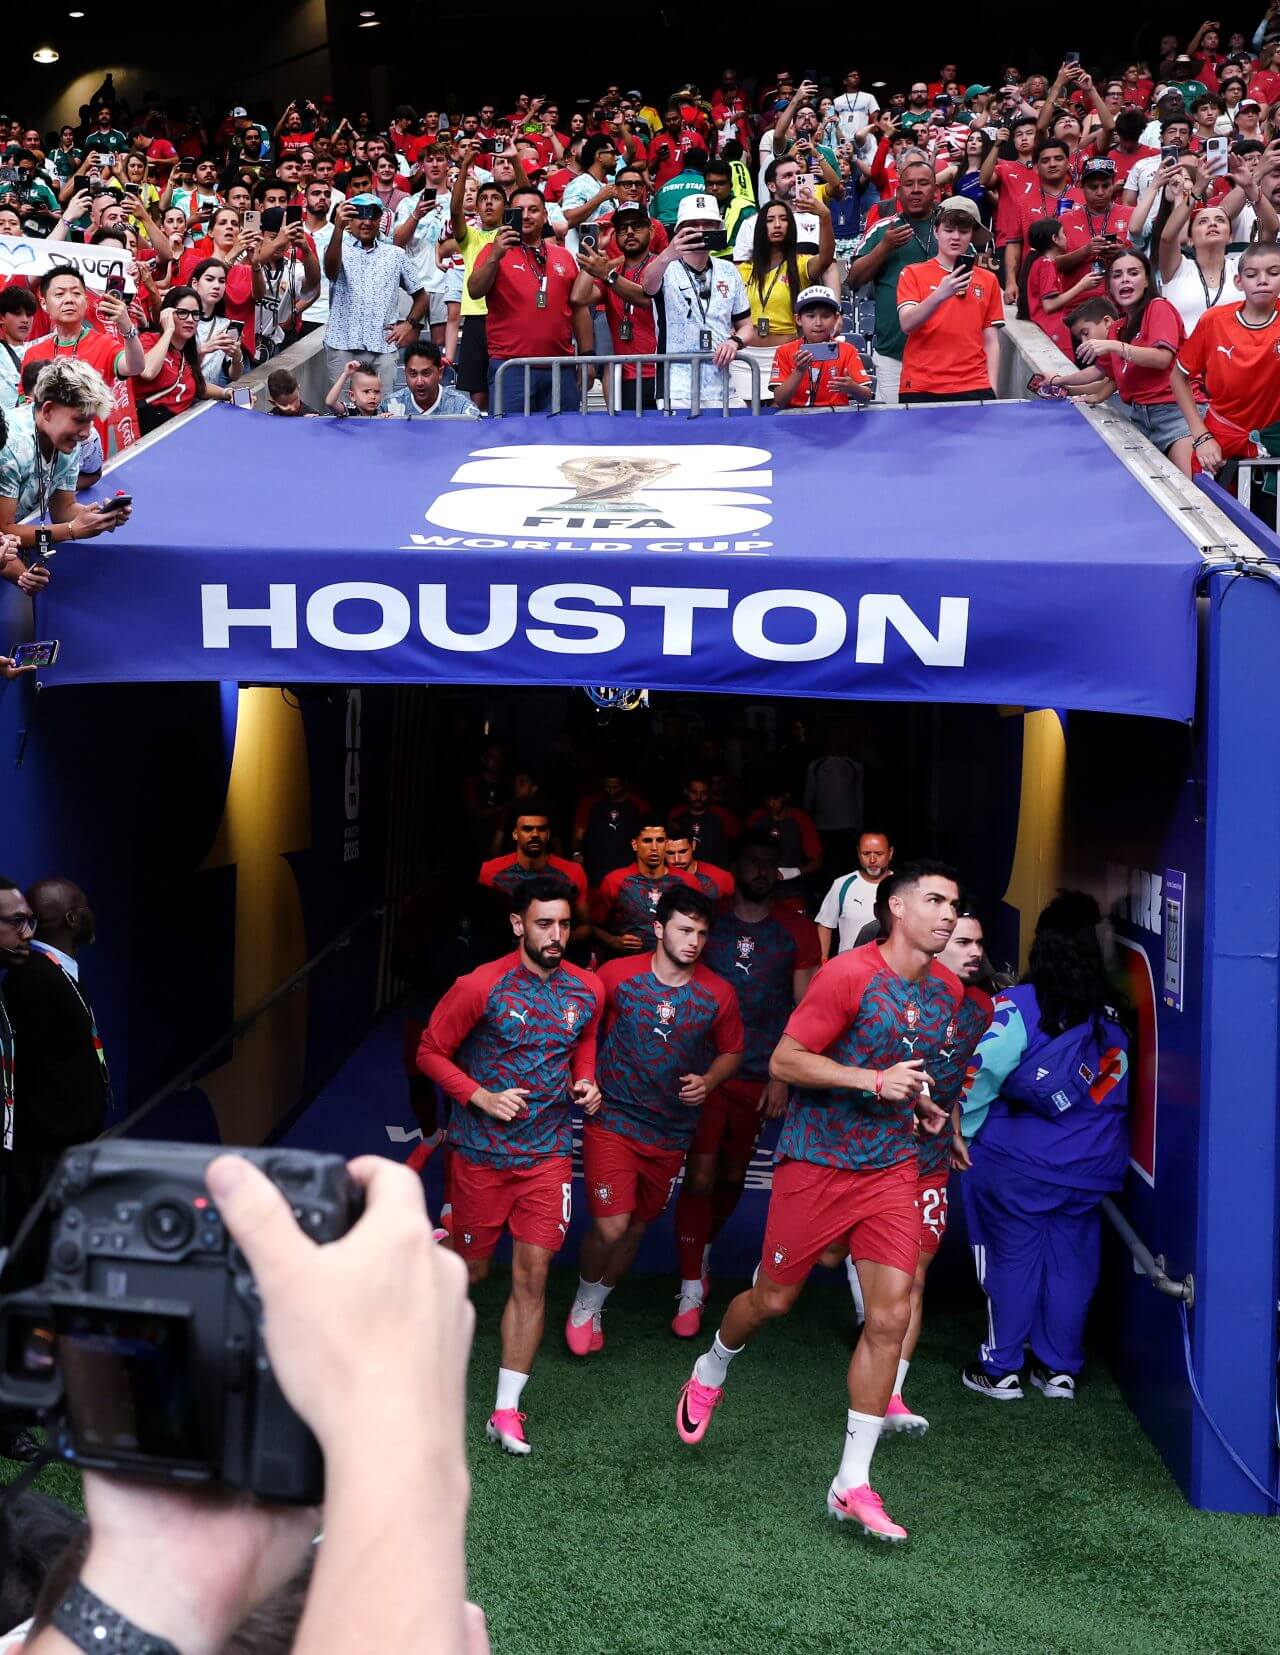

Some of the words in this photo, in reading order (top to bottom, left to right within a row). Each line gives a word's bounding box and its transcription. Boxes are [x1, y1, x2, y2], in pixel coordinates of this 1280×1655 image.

[662, 182, 684, 193] EVENT
[176, 384, 187, 403] 7
[522, 516, 677, 529] FIFA
[409, 533, 633, 553] WORLD
[646, 540, 775, 554] CUP
[200, 581, 970, 668] HOUSTON
[561, 1182, 572, 1223] 8
